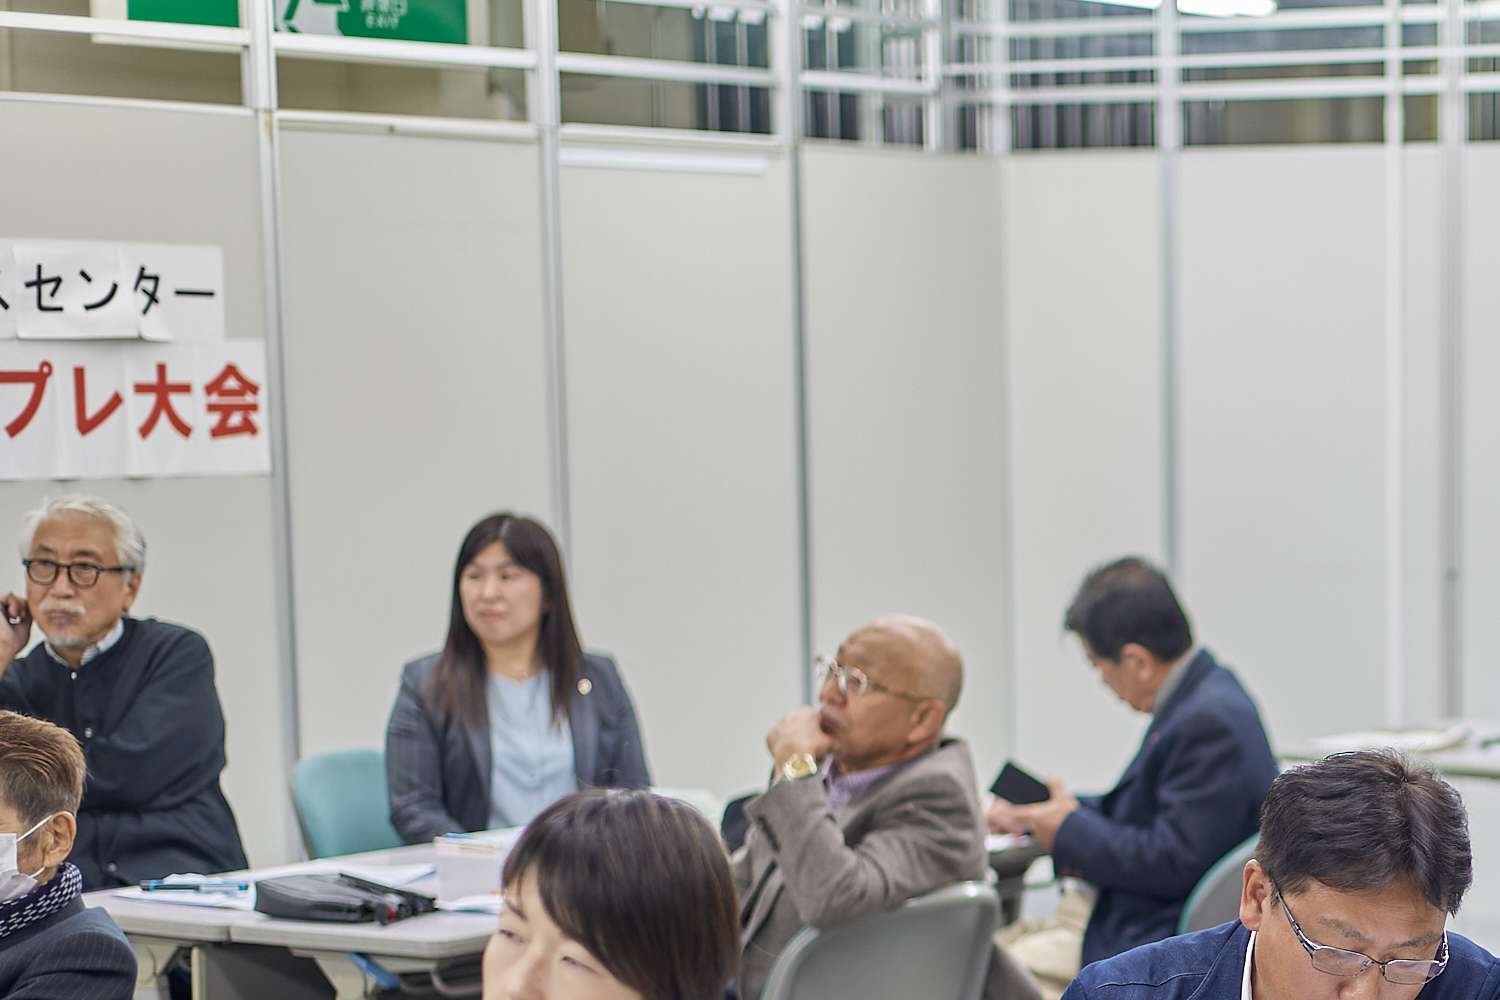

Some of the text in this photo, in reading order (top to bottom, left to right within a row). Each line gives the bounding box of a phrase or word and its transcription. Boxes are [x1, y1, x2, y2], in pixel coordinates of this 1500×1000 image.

[0, 263, 215, 315] センター
[0, 360, 261, 440] プレ大会
